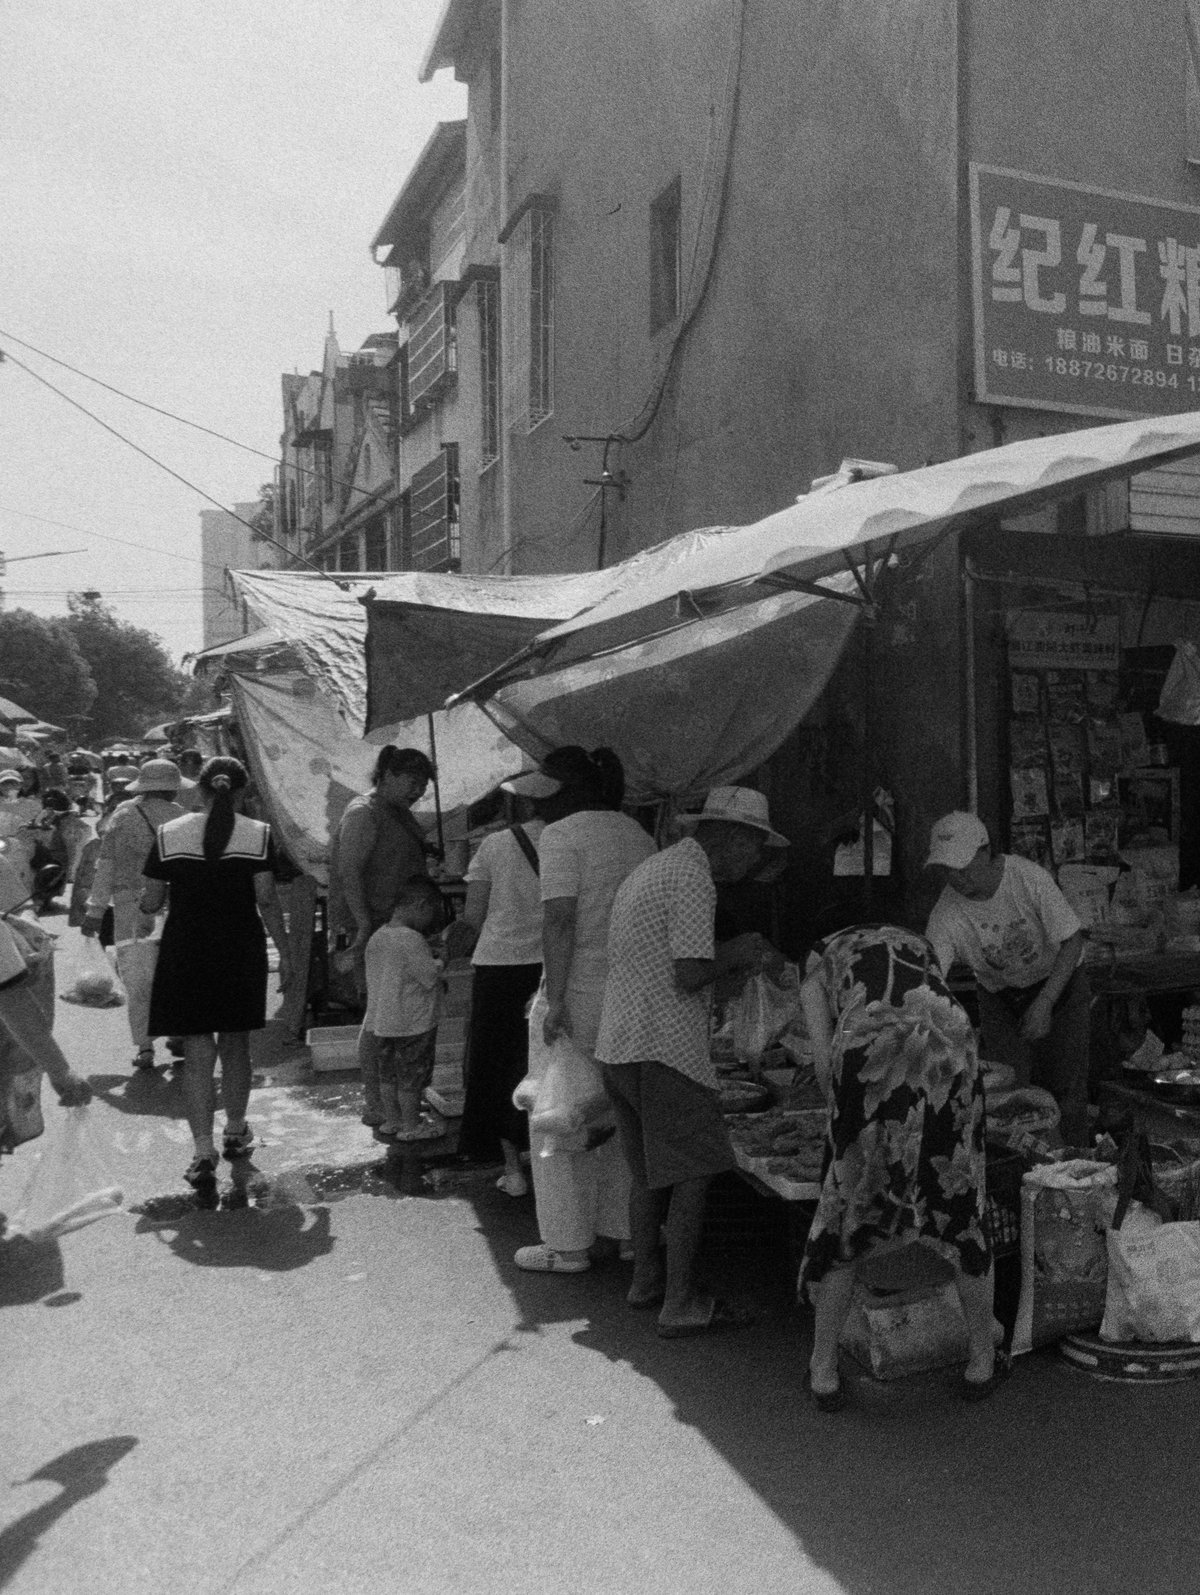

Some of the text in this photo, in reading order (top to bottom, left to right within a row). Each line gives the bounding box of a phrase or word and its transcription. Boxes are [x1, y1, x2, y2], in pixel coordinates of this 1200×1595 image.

[1056, 327, 1149, 361] 粮油米面
[1045, 356, 1180, 389] 18872672894
